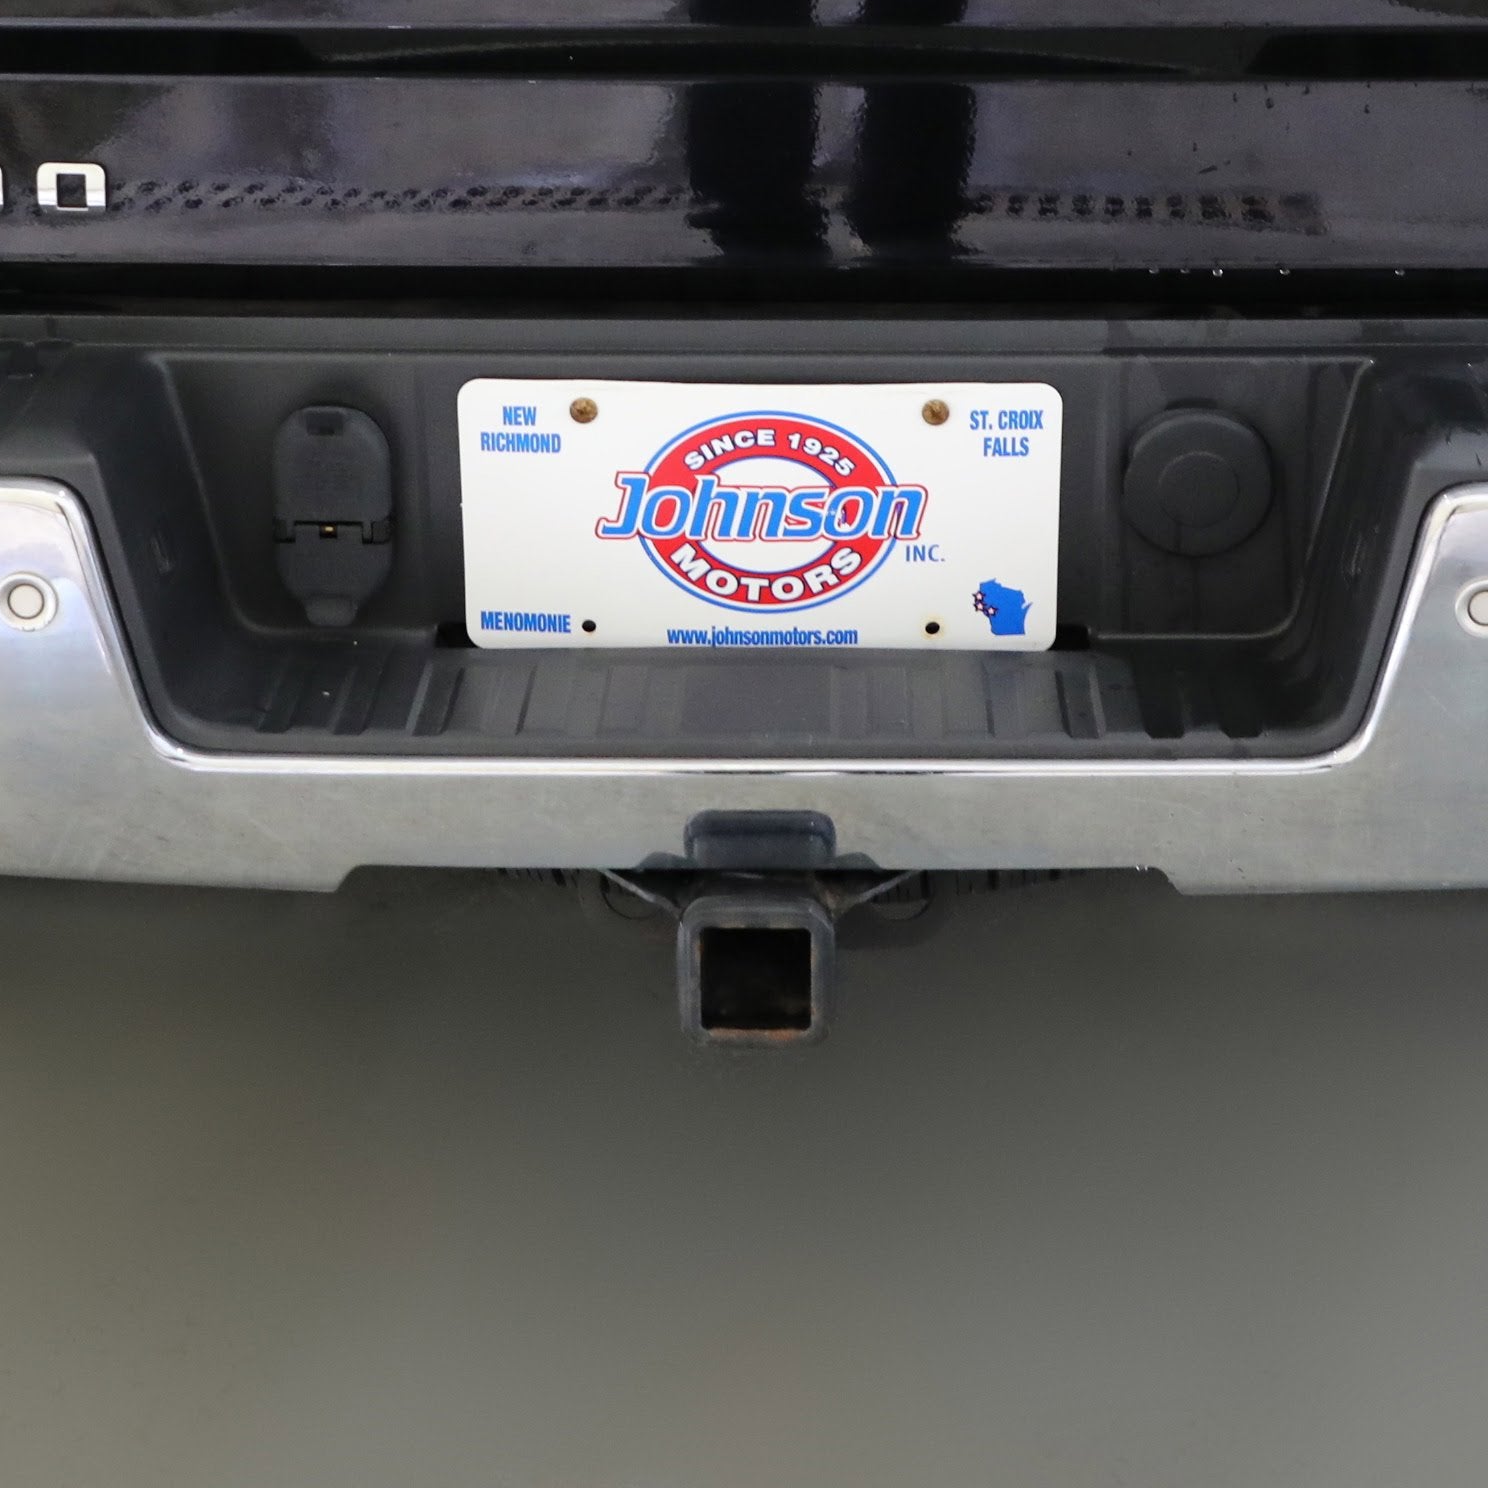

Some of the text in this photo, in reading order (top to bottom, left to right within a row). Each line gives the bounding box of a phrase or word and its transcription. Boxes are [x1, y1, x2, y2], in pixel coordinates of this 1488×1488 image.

[502, 406, 537, 426] NEW
[969, 409, 1044, 431] ST. CROIX
[480, 433, 562, 454] RICHMOND
[683, 429, 857, 477] SINCE 1925
[983, 436, 1029, 457] FALLS
[595, 472, 929, 541] Johnson
[905, 545, 945, 563] INC.
[668, 542, 862, 604] MOTORS
[480, 612, 572, 634] MENOMONIE
[667, 626, 858, 648] www.johnsonmotors.com
